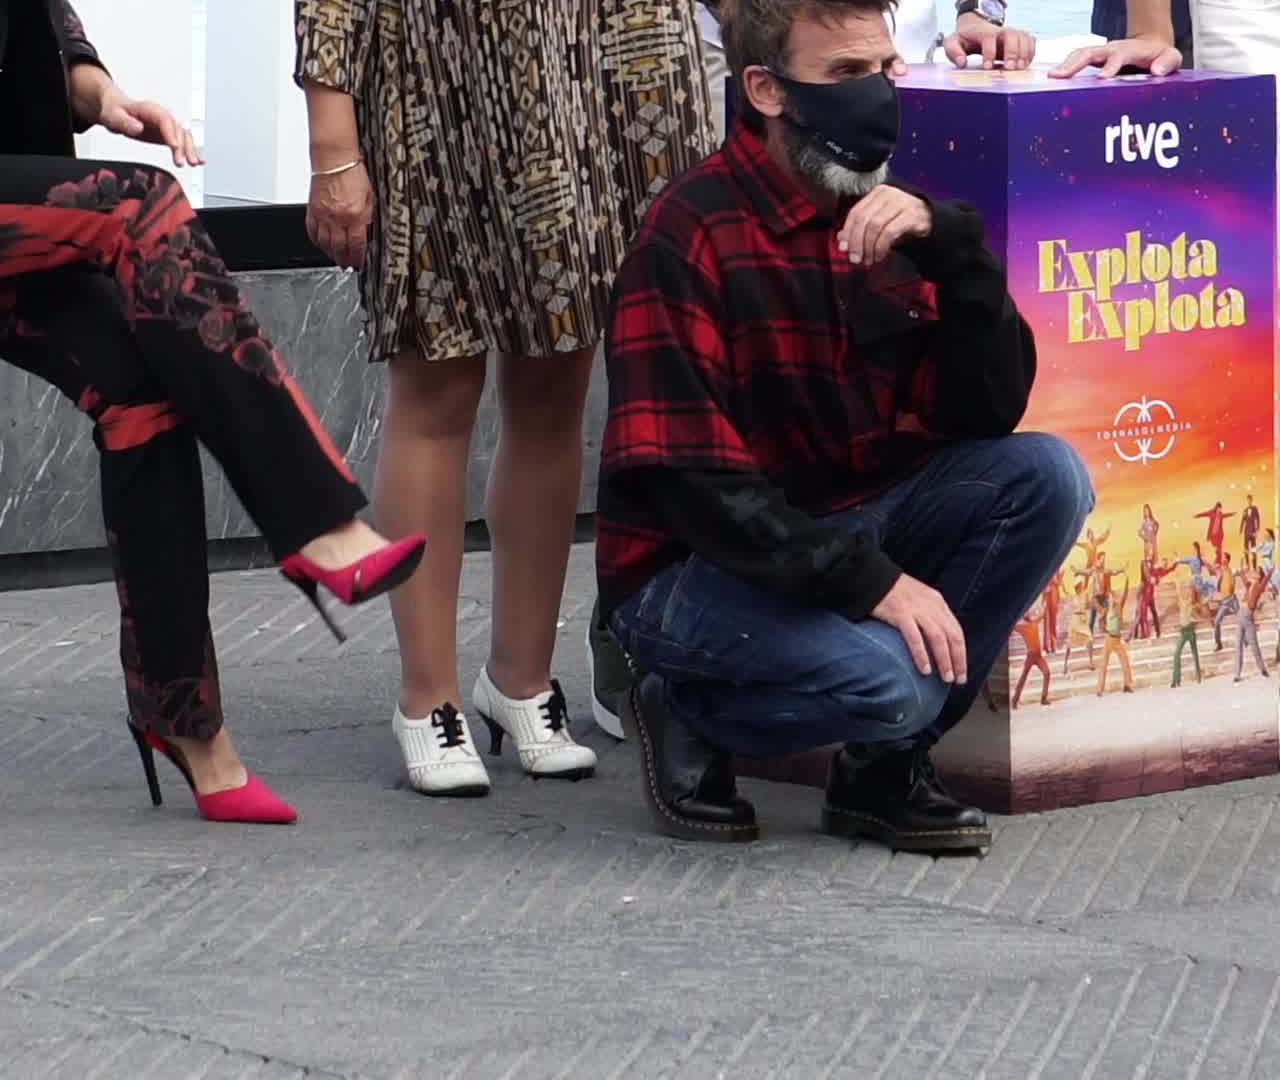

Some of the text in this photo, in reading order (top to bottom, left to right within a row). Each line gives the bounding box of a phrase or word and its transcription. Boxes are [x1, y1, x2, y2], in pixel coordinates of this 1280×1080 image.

[1105, 114, 1180, 168] rtve
[1037, 230, 1218, 303] Explota
[1067, 280, 1247, 352] Explota
